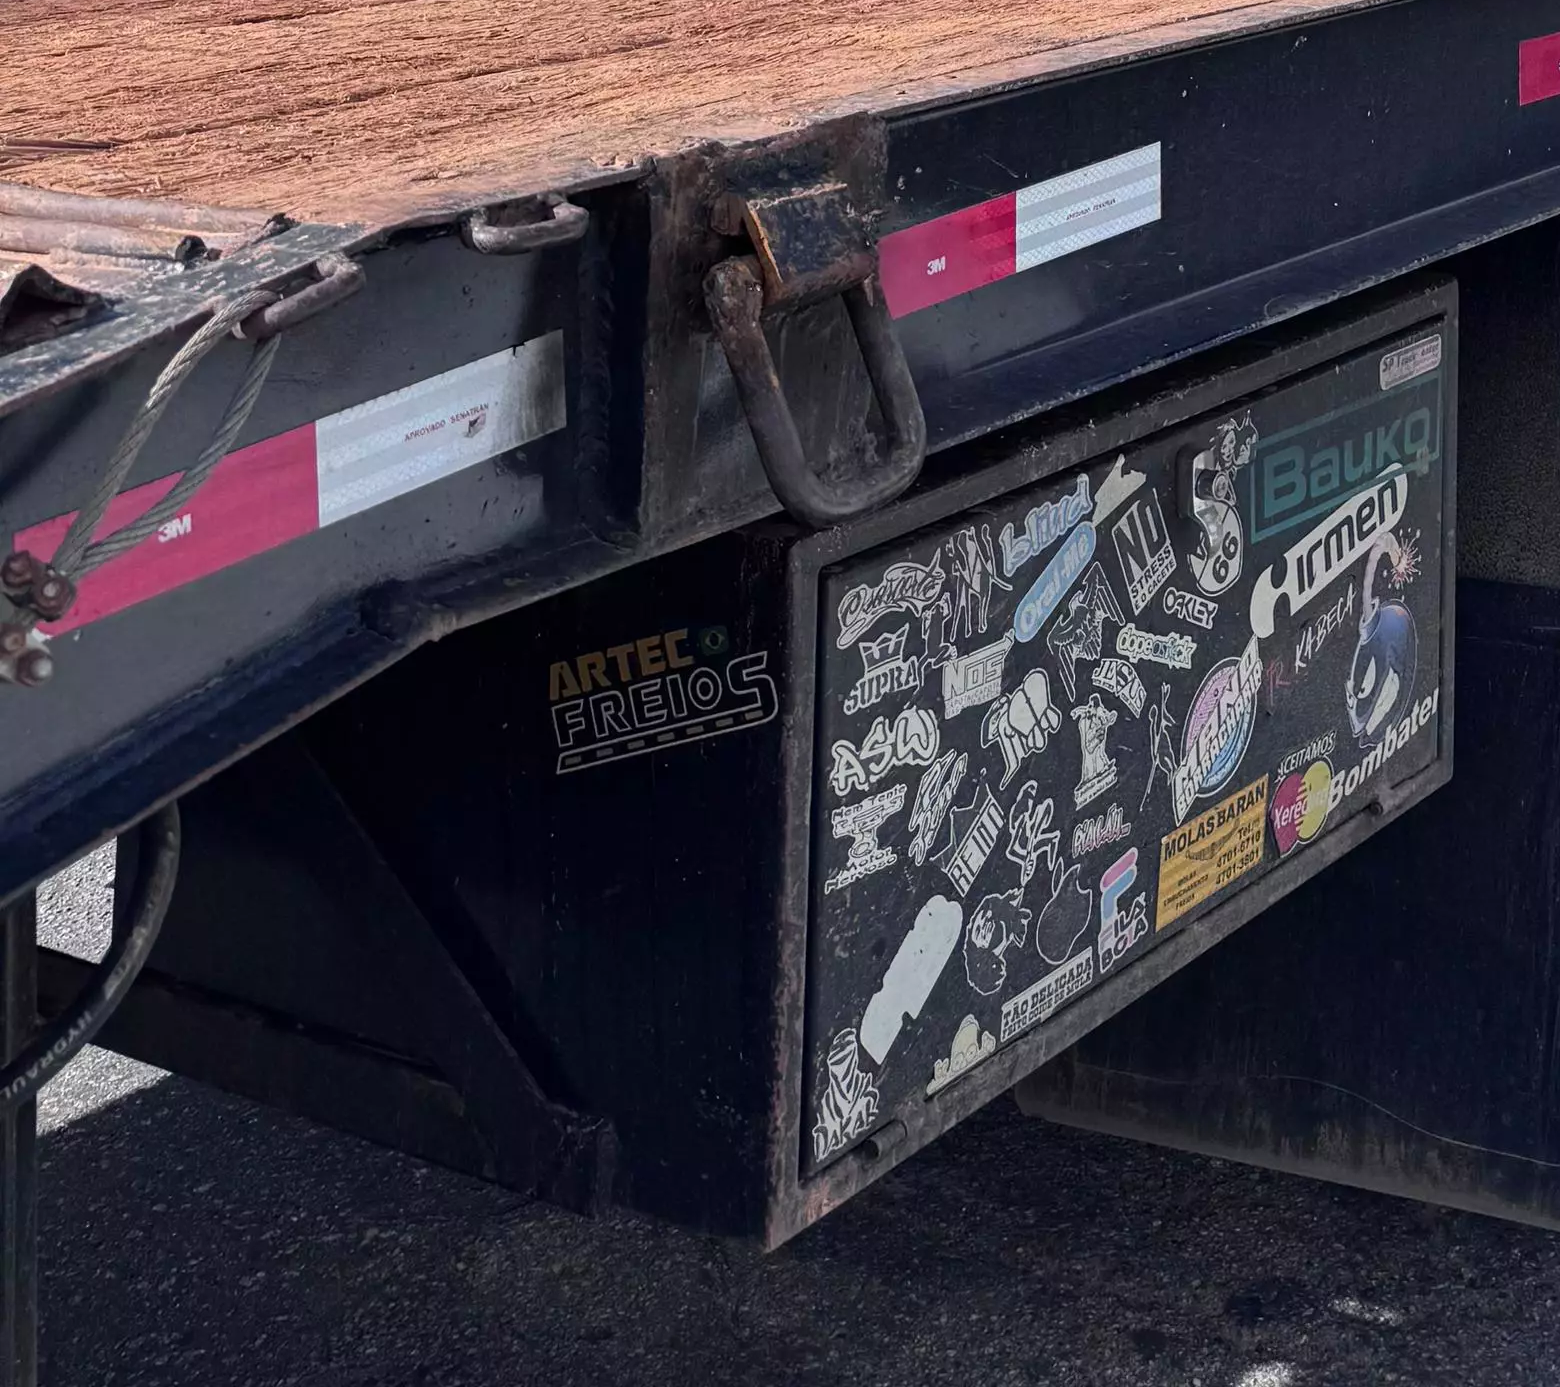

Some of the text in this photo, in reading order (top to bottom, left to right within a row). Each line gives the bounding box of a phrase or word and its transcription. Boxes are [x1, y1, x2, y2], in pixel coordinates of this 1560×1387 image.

[926, 255, 946, 276] 3M
[404, 402, 489, 442] APROVADO SENATRAN
[1264, 407, 1431, 519] Bauko
[157, 513, 192, 543] 3M
[1130, 544, 1171, 599] STRESS
[1148, 560, 1176, 594] CACETE
[1212, 530, 1239, 585] 66
[1163, 587, 1219, 629] OAKLEY
[549, 628, 695, 702] ARTEC
[846, 659, 919, 714] SUPRA
[943, 647, 1005, 701] NOS
[1093, 659, 1147, 713] JESUS
[550, 651, 779, 757] FREIOS
[832, 707, 939, 796] ASW
[1176, 661, 1263, 814] BORRACHARIA
[832, 787, 905, 819] Nem Tente
[1163, 814, 1215, 862] MOLAS
[1216, 781, 1266, 827] BARAN
[826, 854, 897, 894] Nervoso
[847, 848, 892, 870] Motor
[1003, 956, 1092, 1028] TÃO DELICADA
[1066, 971, 1092, 997] MULA
